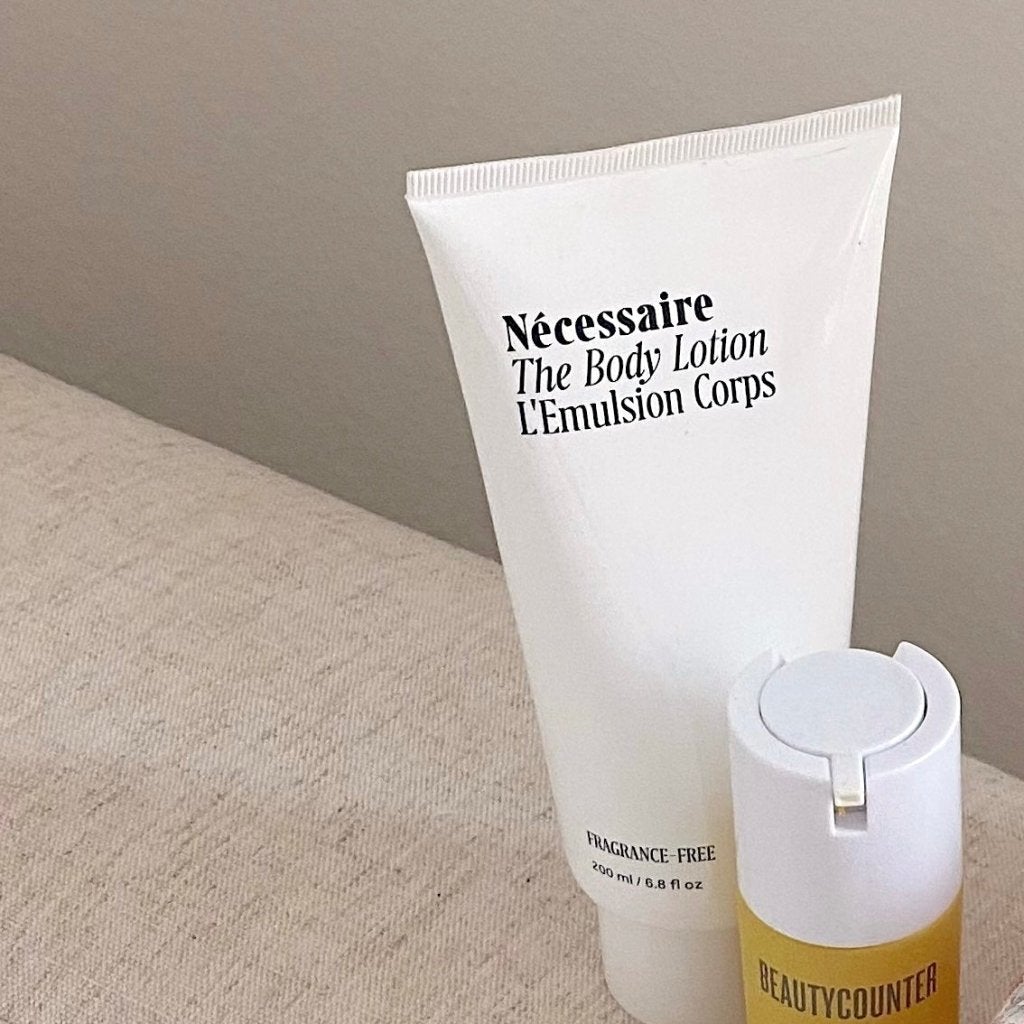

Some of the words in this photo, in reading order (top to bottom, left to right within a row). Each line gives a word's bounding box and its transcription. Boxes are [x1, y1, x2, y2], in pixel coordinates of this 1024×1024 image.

[502, 291, 714, 352] Nécessaire
[512, 356, 572, 395] The
[584, 341, 661, 387] Body
[673, 328, 768, 372] Lotion
[517, 387, 684, 435] L'Emulsion
[694, 370, 776, 408] Corps
[586, 830, 716, 863] FRAGRANCE-FREE
[592, 861, 614, 878] 200
[617, 873, 633, 885] ml
[636, 876, 641, 886] /
[645, 878, 666, 889] 6.8
[670, 878, 680, 890] fl
[685, 881, 703, 890] oz
[759, 958, 937, 1020] BEAUTYCOUNTER
